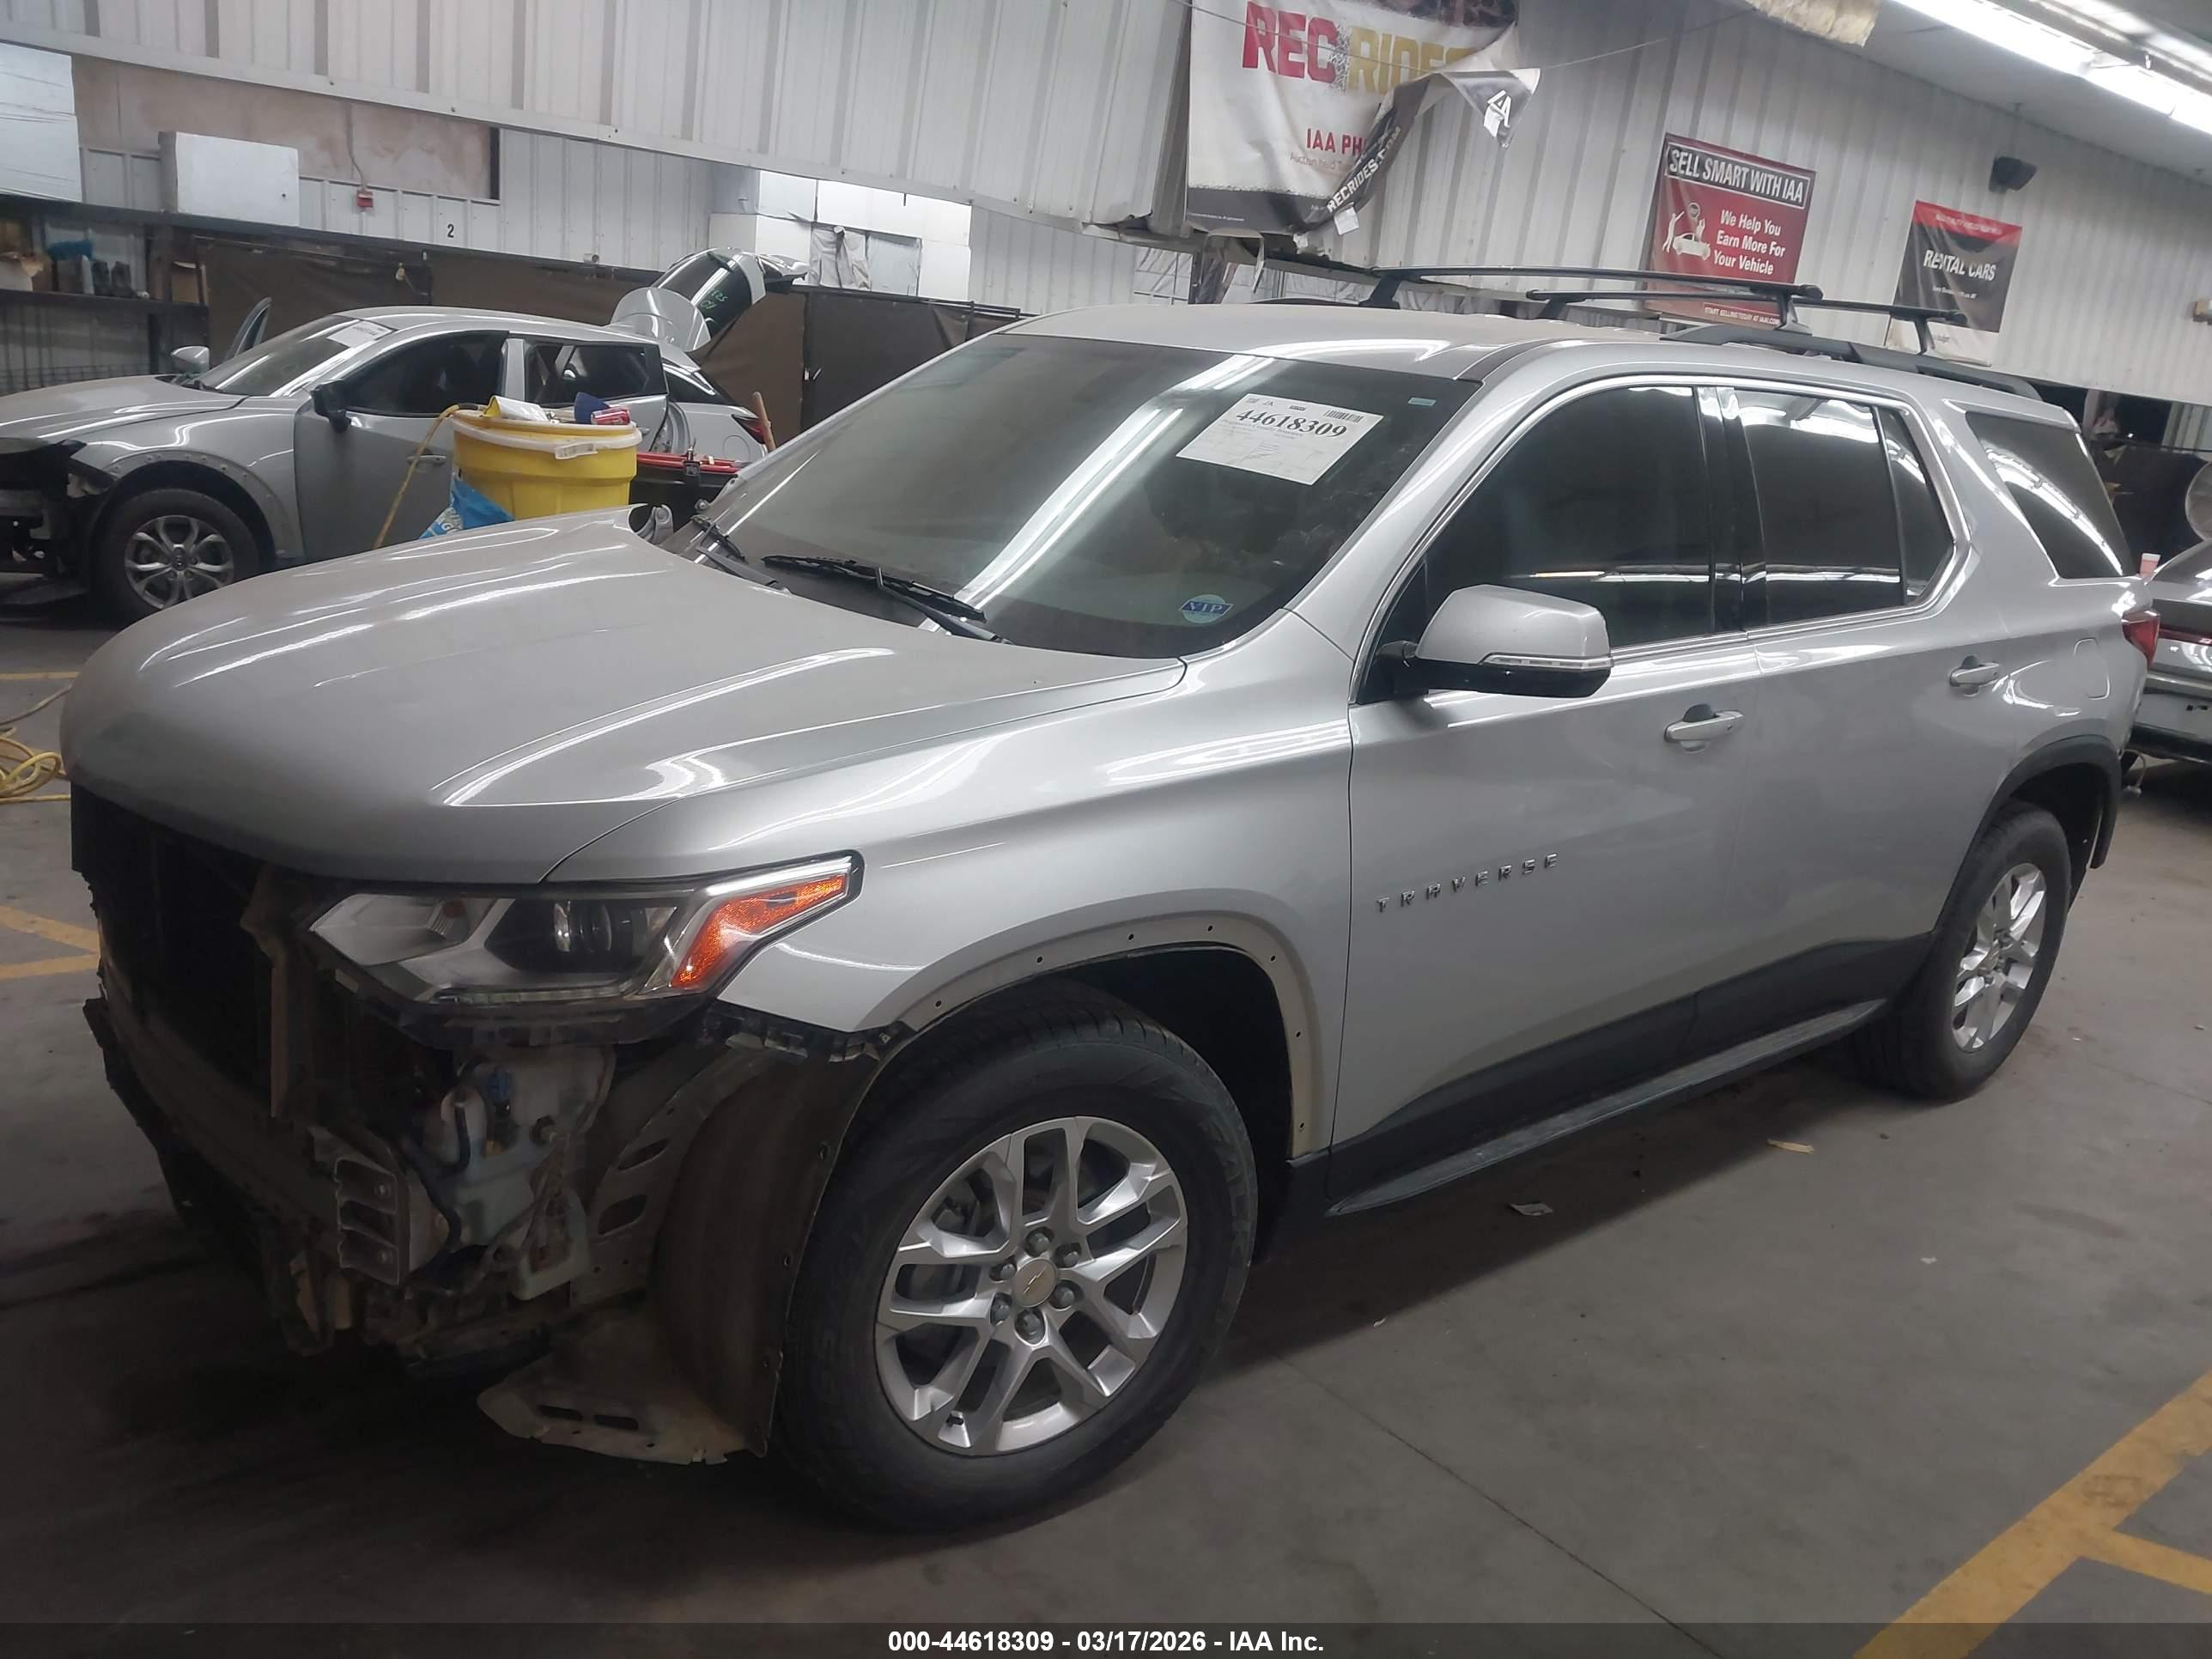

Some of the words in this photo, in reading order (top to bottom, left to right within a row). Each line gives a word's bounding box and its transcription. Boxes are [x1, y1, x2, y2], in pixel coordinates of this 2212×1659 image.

[1243, 1, 1338, 83] REC
[1307, 128, 1336, 153] IAA
[1327, 126, 1401, 214] RECRIDES.
[1669, 149, 1700, 178] SELL
[1702, 157, 1749, 189] SMART
[1749, 169, 1784, 198] WITH
[1782, 178, 1804, 204] IAA
[447, 223, 454, 238] 2
[1720, 209, 1736, 227] We
[1738, 213, 1761, 234] Help
[1764, 218, 1782, 236] You
[1717, 229, 1740, 248] Earn
[1741, 234, 1768, 253] More
[1769, 240, 1786, 258] For
[1714, 249, 1736, 267] Your
[1739, 254, 1774, 275] Vehicle
[1923, 249, 1966, 276] RENTAL
[1968, 262, 1996, 282] CARS
[1236, 409, 1347, 438] 44618309
[1376, 854, 1558, 913] TRAVERSE
